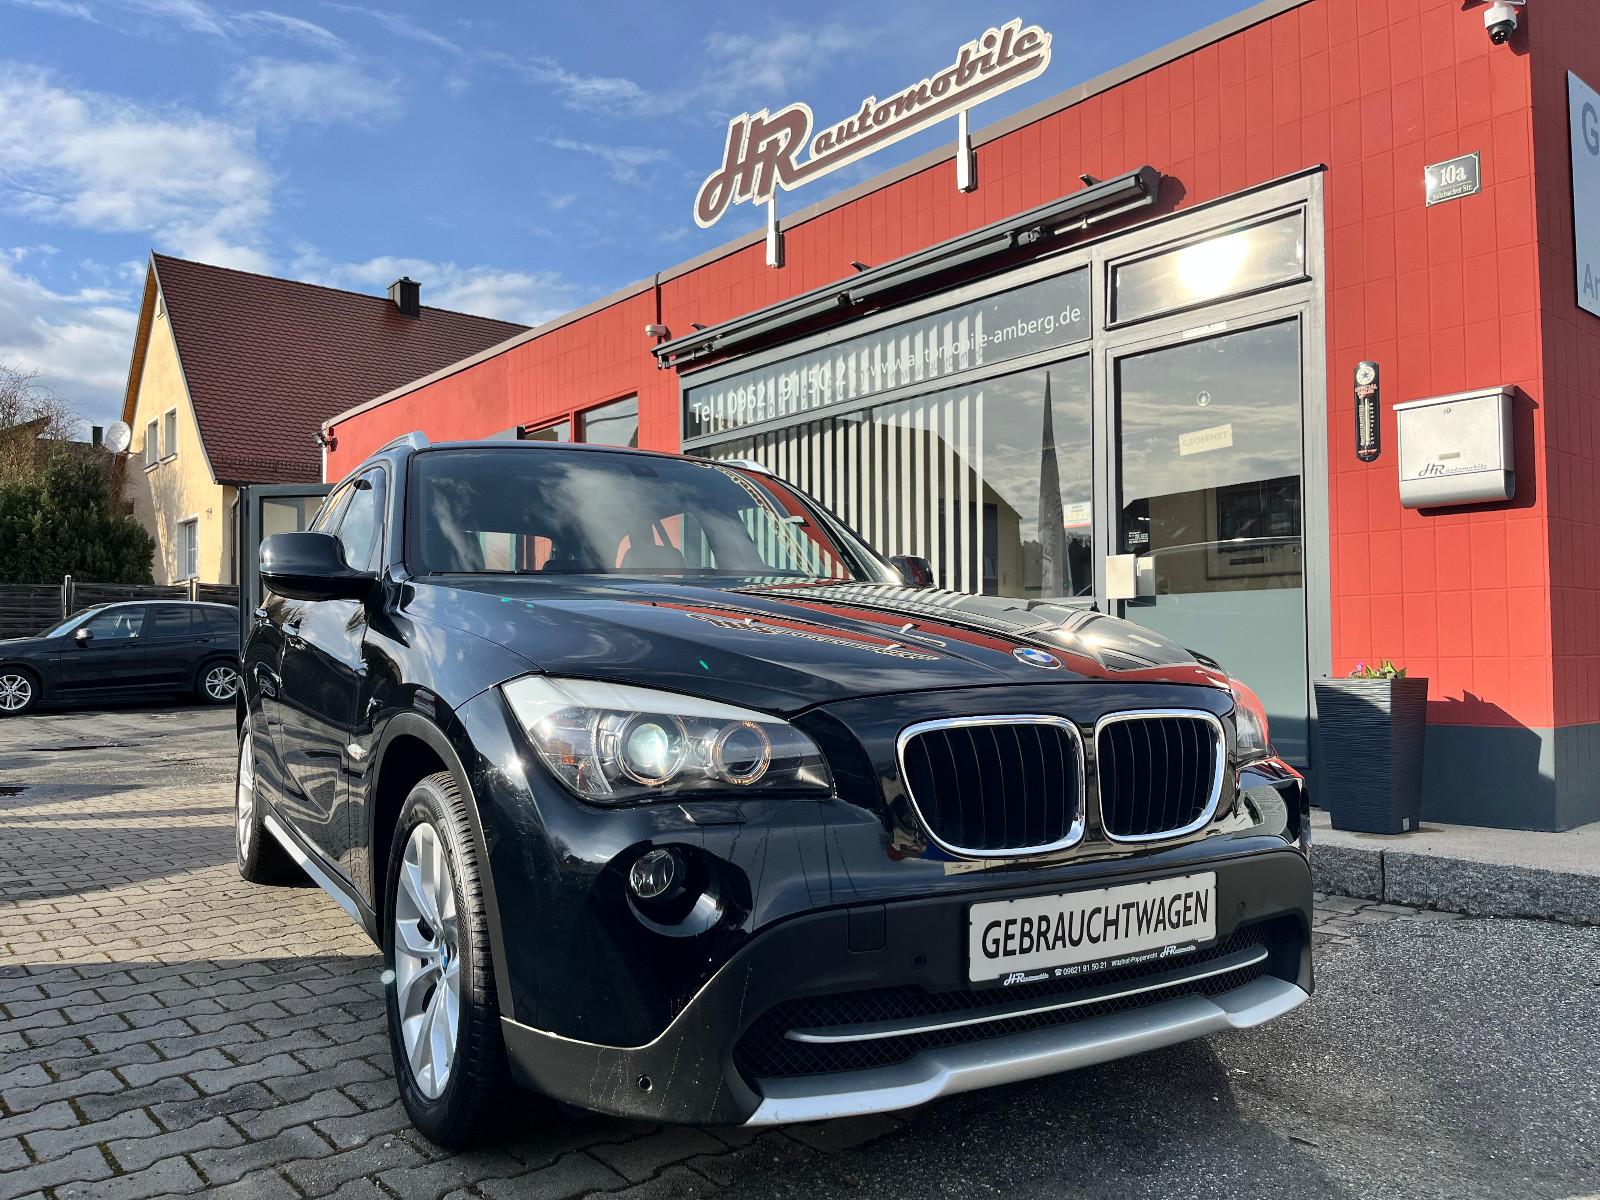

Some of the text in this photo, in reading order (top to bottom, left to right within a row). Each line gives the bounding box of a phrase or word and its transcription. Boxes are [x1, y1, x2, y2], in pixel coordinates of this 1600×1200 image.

[1440, 164, 1467, 187] 10a
[726, 383, 775, 415] 0962
[981, 888, 1209, 960] GEBRAUCHTWAGEN
[1062, 966, 1081, 976] 09621
[1082, 964, 1090, 972] 91
[1099, 961, 1107, 969] 21
